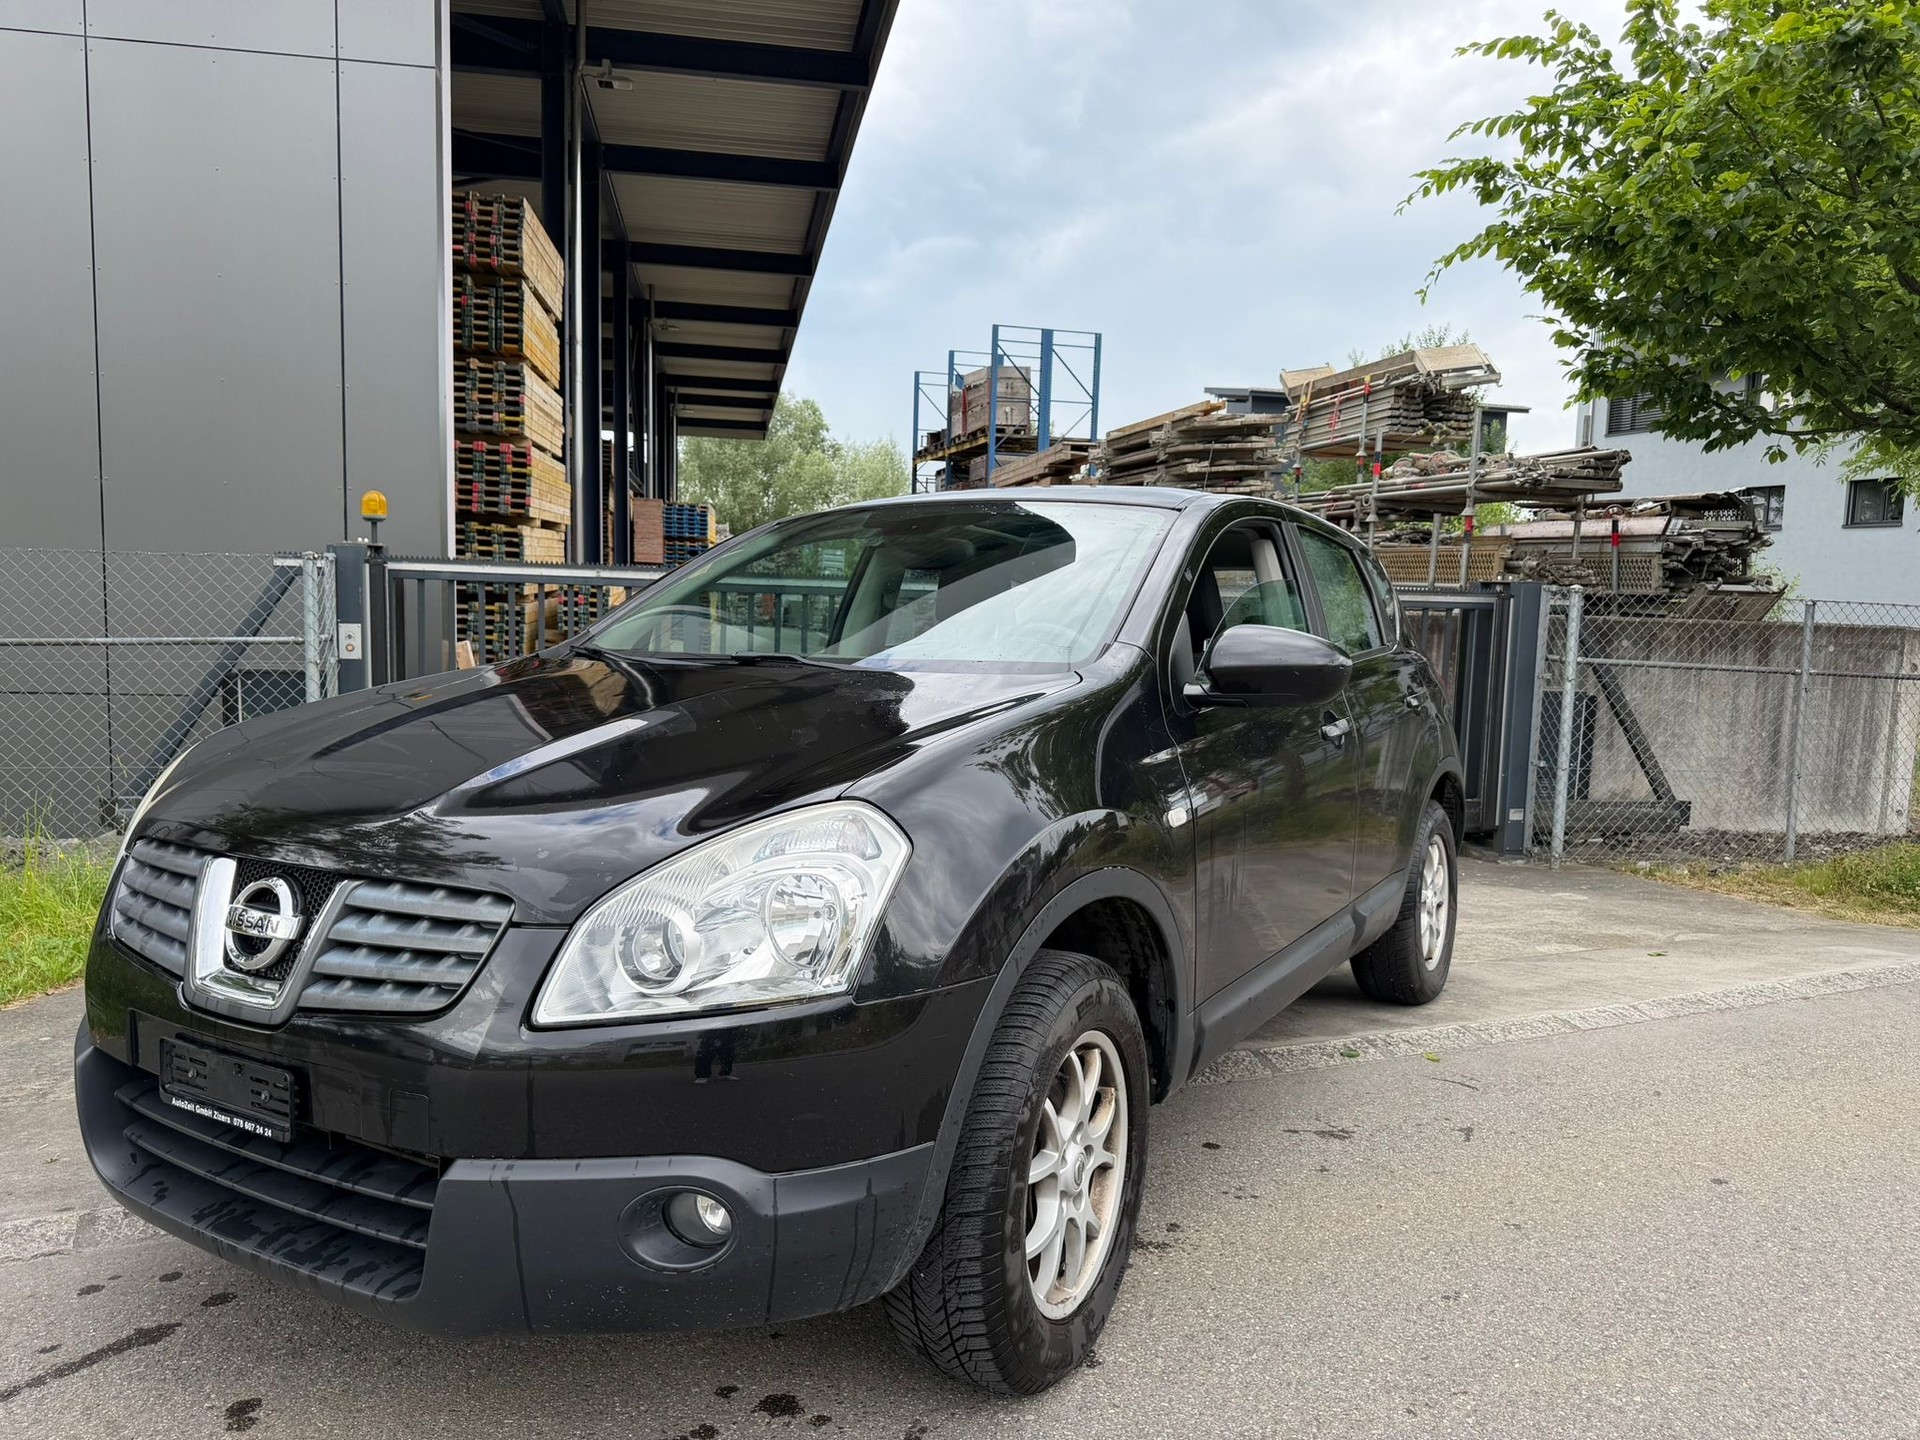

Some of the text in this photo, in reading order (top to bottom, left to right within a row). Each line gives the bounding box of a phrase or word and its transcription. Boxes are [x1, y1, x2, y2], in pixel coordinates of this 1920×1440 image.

[227, 907, 280, 933] NISSAN
[171, 1097, 272, 1137] AutoZeit GmbH Zizers 078 607 24 24
